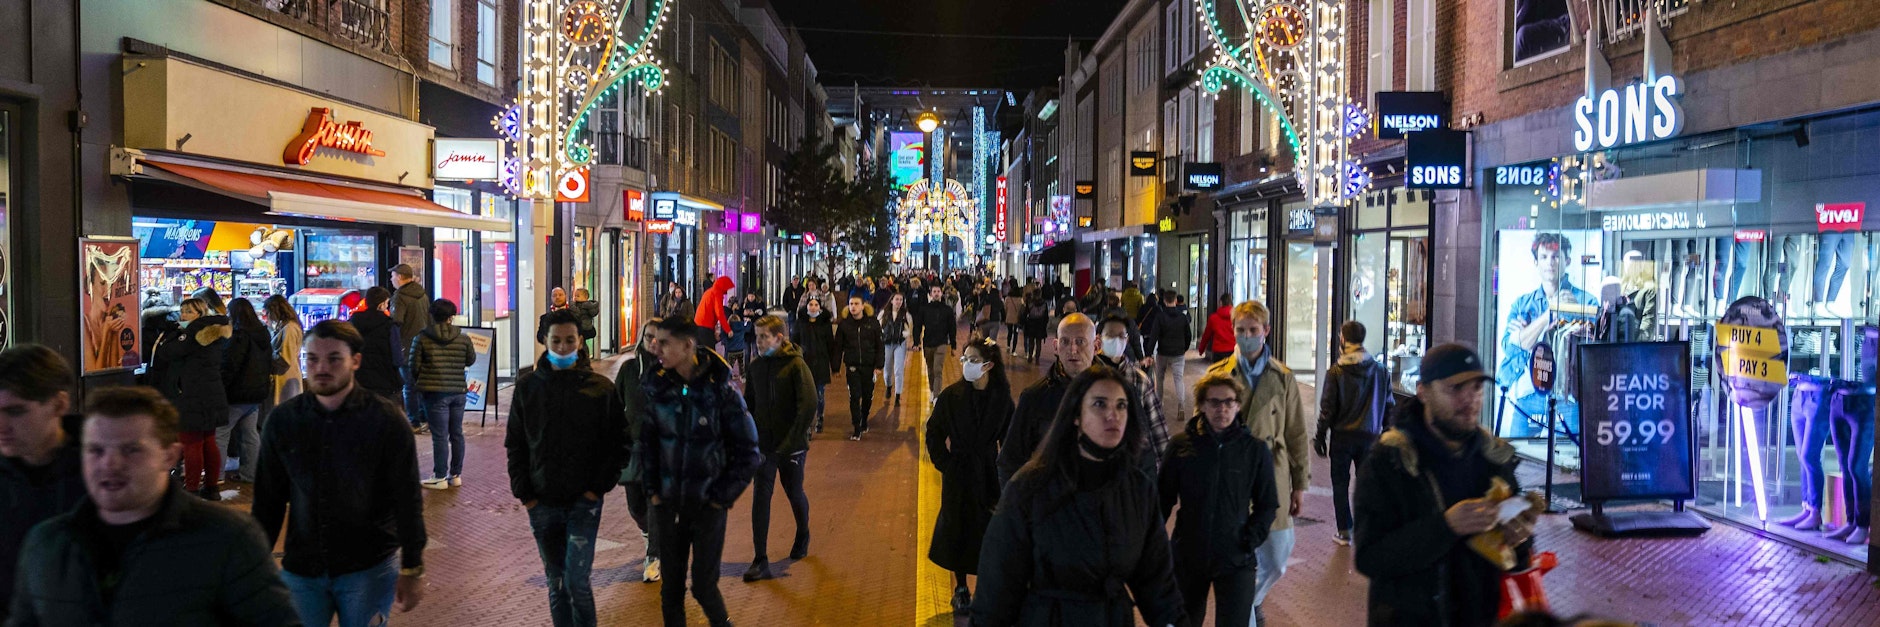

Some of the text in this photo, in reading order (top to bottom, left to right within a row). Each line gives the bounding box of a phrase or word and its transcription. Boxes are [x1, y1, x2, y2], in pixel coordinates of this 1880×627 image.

[1383, 114, 1438, 129] NELSON
[1574, 75, 1676, 152] SONS
[1189, 174, 1219, 184] NELSON
[1412, 165, 1461, 184] SONS
[1731, 328, 1762, 346] BUY 4
[1739, 359, 1768, 377] PAY 3
[1602, 373, 1670, 392] JEANS
[1607, 393, 1665, 411] 2 FOR
[1596, 420, 1676, 446] 59.99
